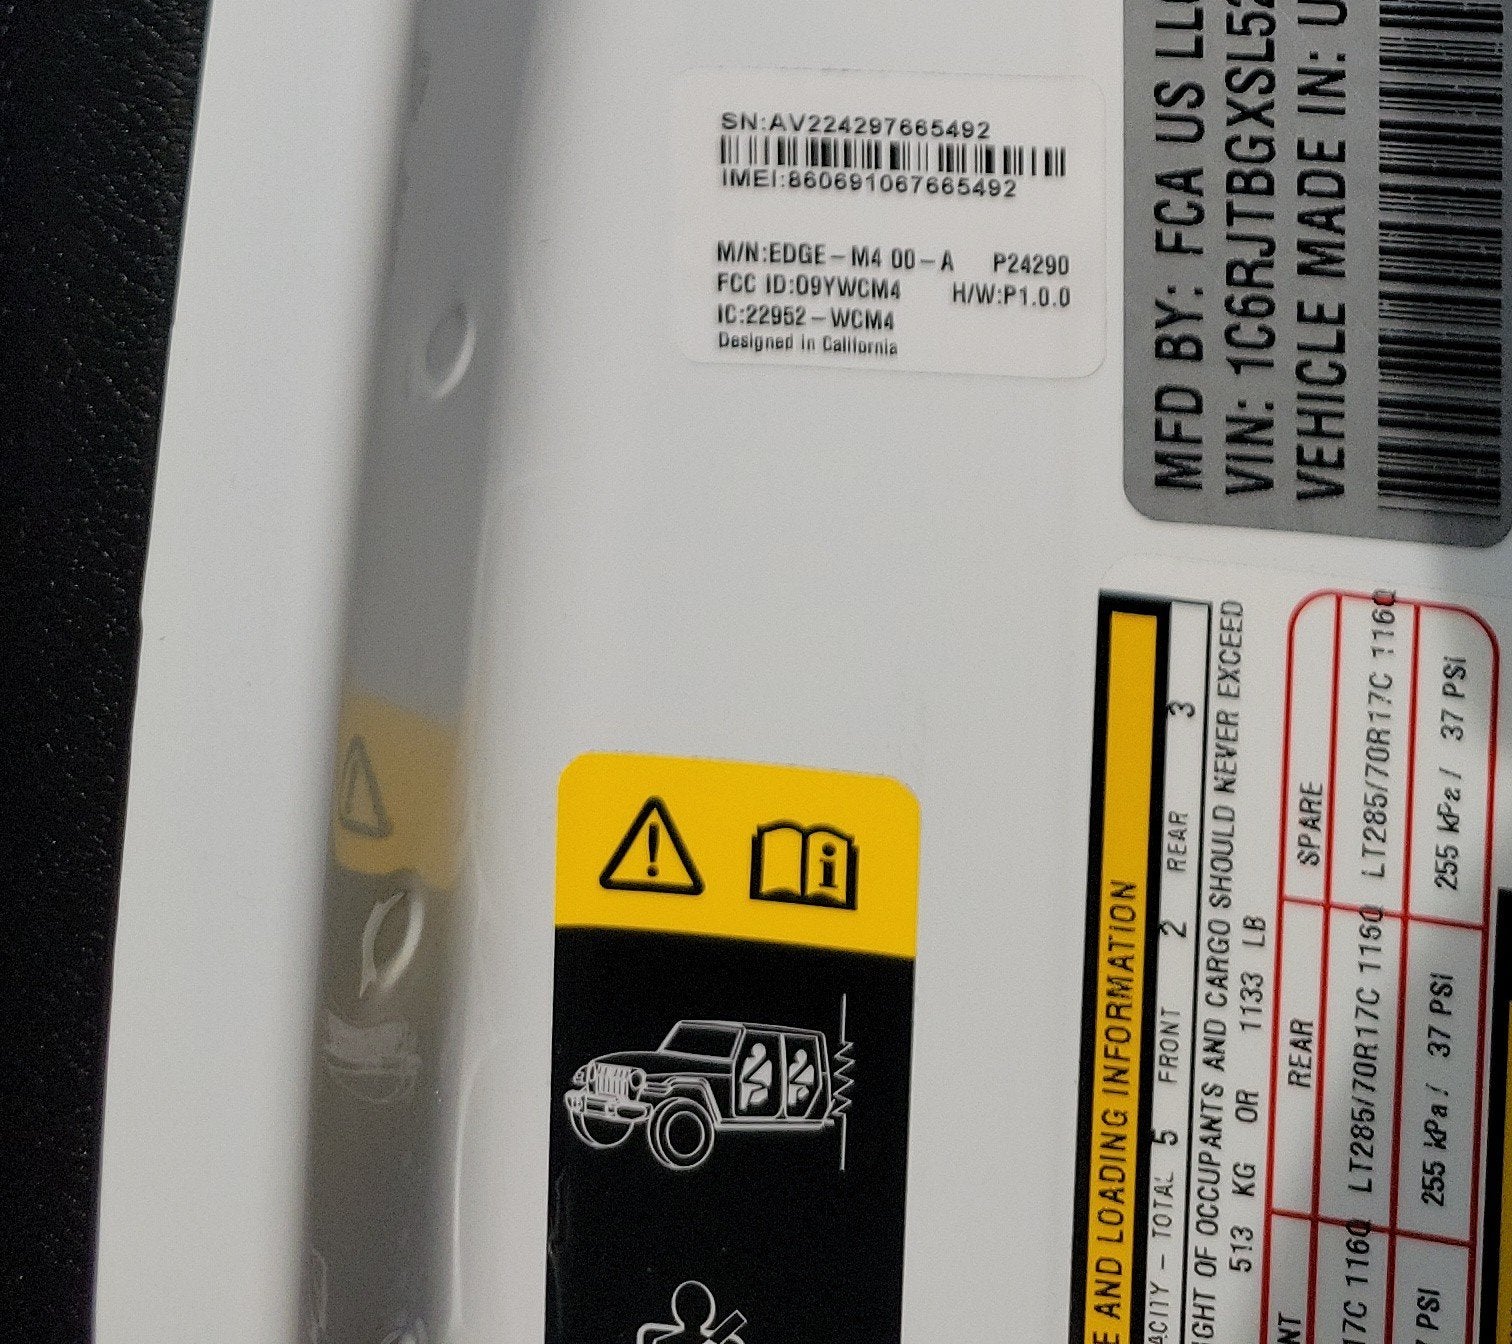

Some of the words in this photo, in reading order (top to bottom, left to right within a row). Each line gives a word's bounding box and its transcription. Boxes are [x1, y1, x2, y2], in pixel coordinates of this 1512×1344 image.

[1297, 53, 1346, 115] IN:
[721, 113, 990, 139] SN:AV224297665492
[1154, 82, 1205, 143] US
[722, 168, 1017, 198] IMEI:860691067665492
[1297, 139, 1345, 278] MADE
[1154, 168, 1204, 255] FCA
[994, 253, 1069, 276] P24290
[717, 273, 755, 293] FCC
[953, 283, 1070, 308] H/W:P1.0.0
[719, 332, 793, 352] Designed
[801, 335, 815, 351] in
[823, 336, 897, 356] California
[1155, 286, 1203, 362] BY:
[1295, 301, 1346, 501] VEHICLE
[1154, 385, 1203, 491] MFD
[1225, 401, 1274, 496] VIN:
[1217, 601, 1243, 699] EXCEED
[1442, 657, 1467, 699] PSI
[1165, 699, 1195, 718] 3
[1440, 709, 1464, 741] 37
[1214, 711, 1238, 794] NEVER
[1361, 673, 1393, 879] LT285/70R17C
[1439, 767, 1462, 780] /
[1297, 783, 1322, 866] SPARE
[1437, 788, 1460, 834] kPa
[1167, 813, 1186, 871] REAR
[1209, 806, 1235, 908] SHOULD
[1434, 846, 1458, 891] 255
[1158, 919, 1186, 938] 2
[1242, 916, 1266, 947] LB
[1103, 882, 1135, 1095] INFORMATION
[1205, 920, 1230, 1007] CARGO
[1239, 972, 1263, 1031] 1133
[1429, 974, 1453, 1016] PSI
[1158, 1009, 1178, 1082] FRONT
[1203, 1020, 1226, 1071] AND
[1288, 1019, 1313, 1088] REAR
[1427, 1025, 1451, 1058] 37
[1235, 1090, 1258, 1123] OR
[1348, 989, 1379, 1194] LT285/70R17C
[1425, 1083, 1449, 1097] /
[1153, 1130, 1178, 1147] 5
[1424, 1105, 1447, 1150] kPa
[1097, 1110, 1128, 1243] LOADING
[1196, 1083, 1223, 1236] OCCUPANTS
[1232, 1163, 1255, 1197] KG
[1421, 1161, 1445, 1207] 255
[1152, 1177, 1173, 1237] TOTAL
[1194, 1246, 1217, 1278] OF
[1229, 1226, 1253, 1273] 513
[1094, 1258, 1122, 1320] AND
[1416, 1288, 1440, 1330] PSI
